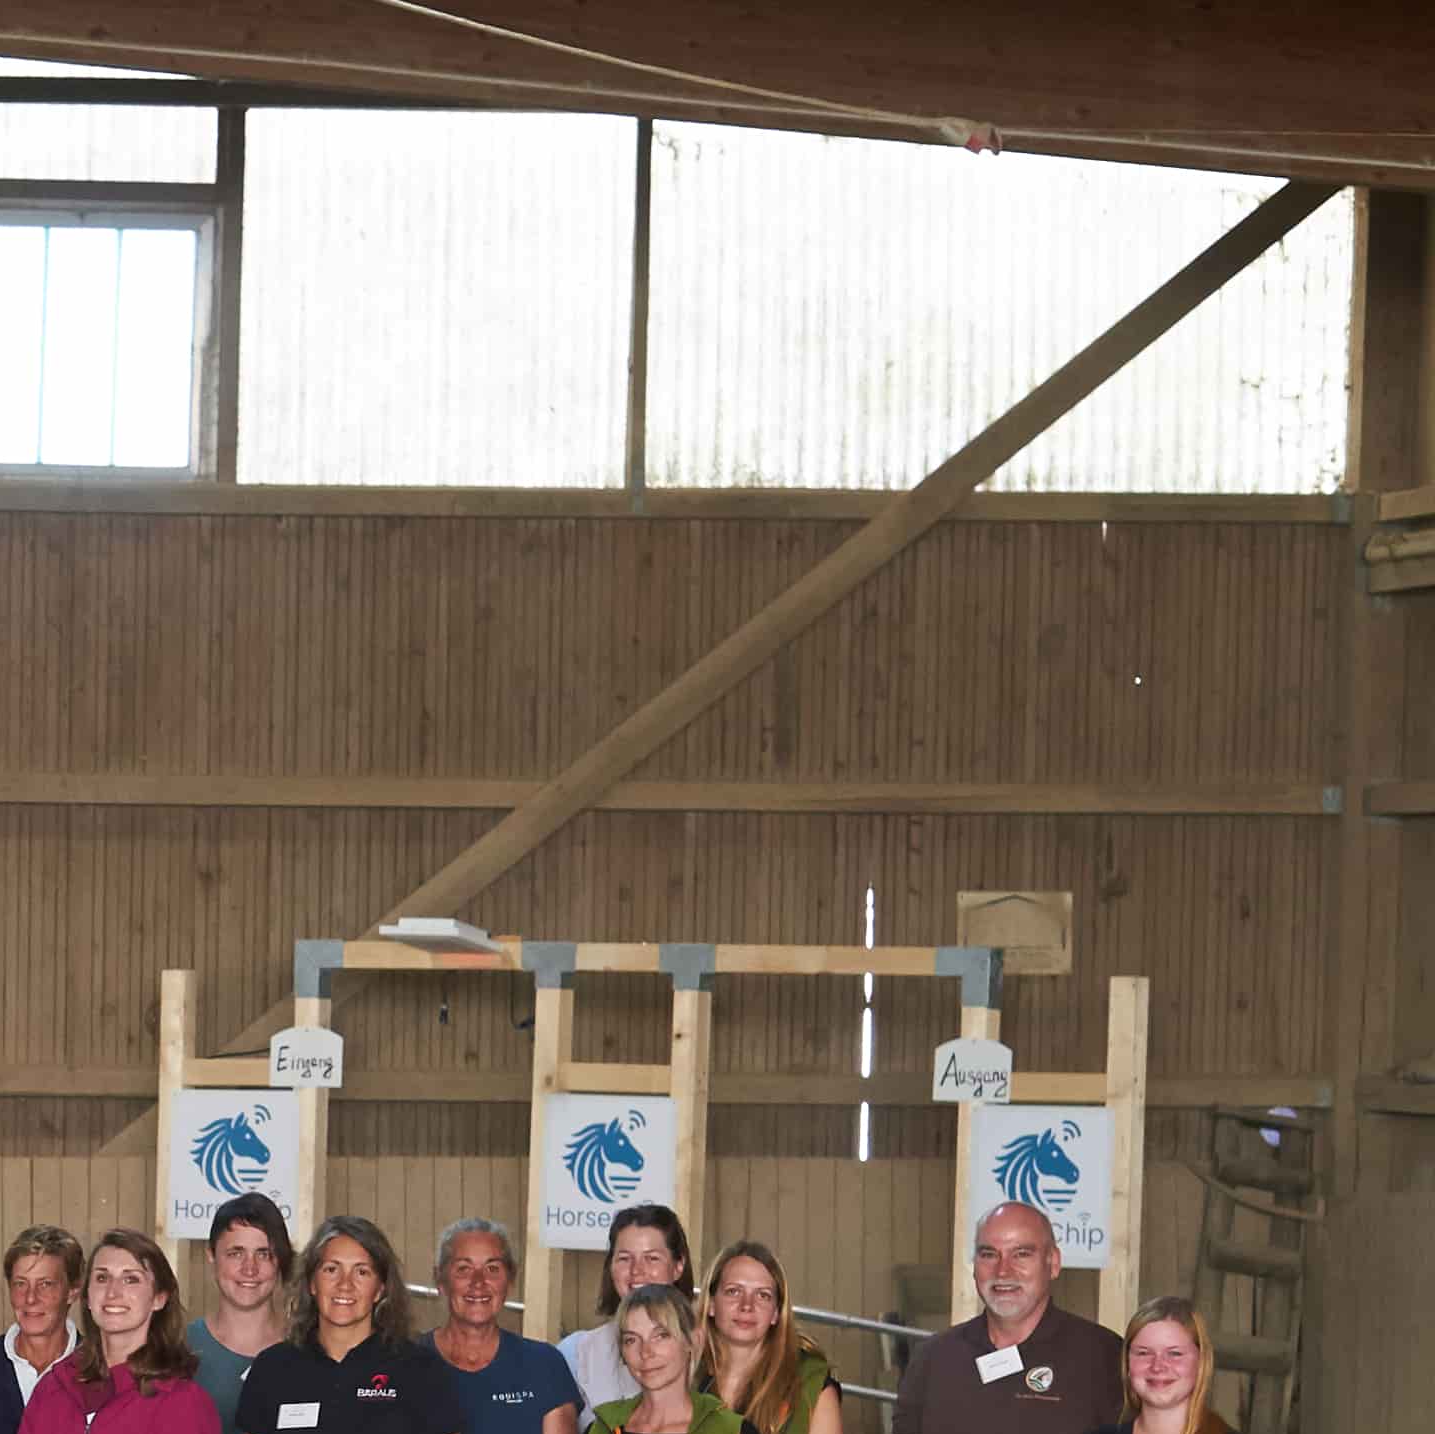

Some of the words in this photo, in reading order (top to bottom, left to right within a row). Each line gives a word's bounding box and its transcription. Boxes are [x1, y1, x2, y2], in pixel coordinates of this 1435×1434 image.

[277, 1045, 334, 1079] Eingang
[940, 1052, 1009, 1099] Ausgang
[546, 1205, 612, 1228] Horse
